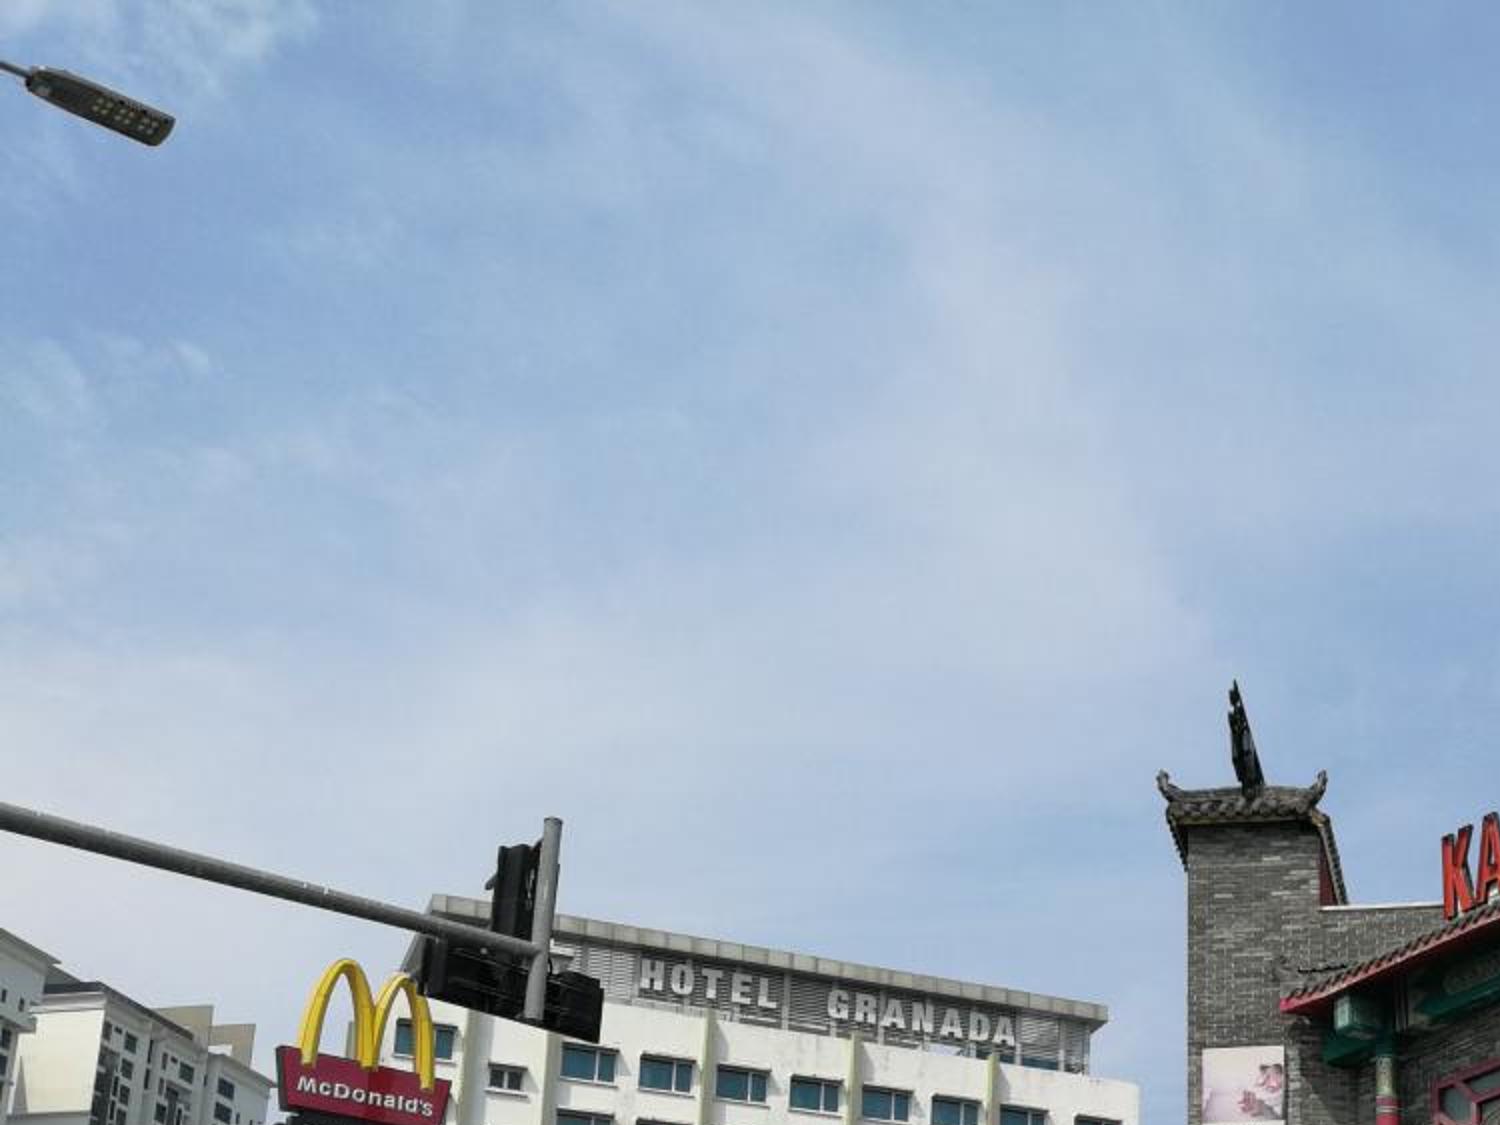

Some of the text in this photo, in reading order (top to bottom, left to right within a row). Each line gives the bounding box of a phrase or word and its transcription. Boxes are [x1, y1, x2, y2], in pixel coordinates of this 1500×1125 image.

[640, 958, 1017, 1047] HOTEL GRANADA
[297, 1075, 433, 1117] McDonald's
